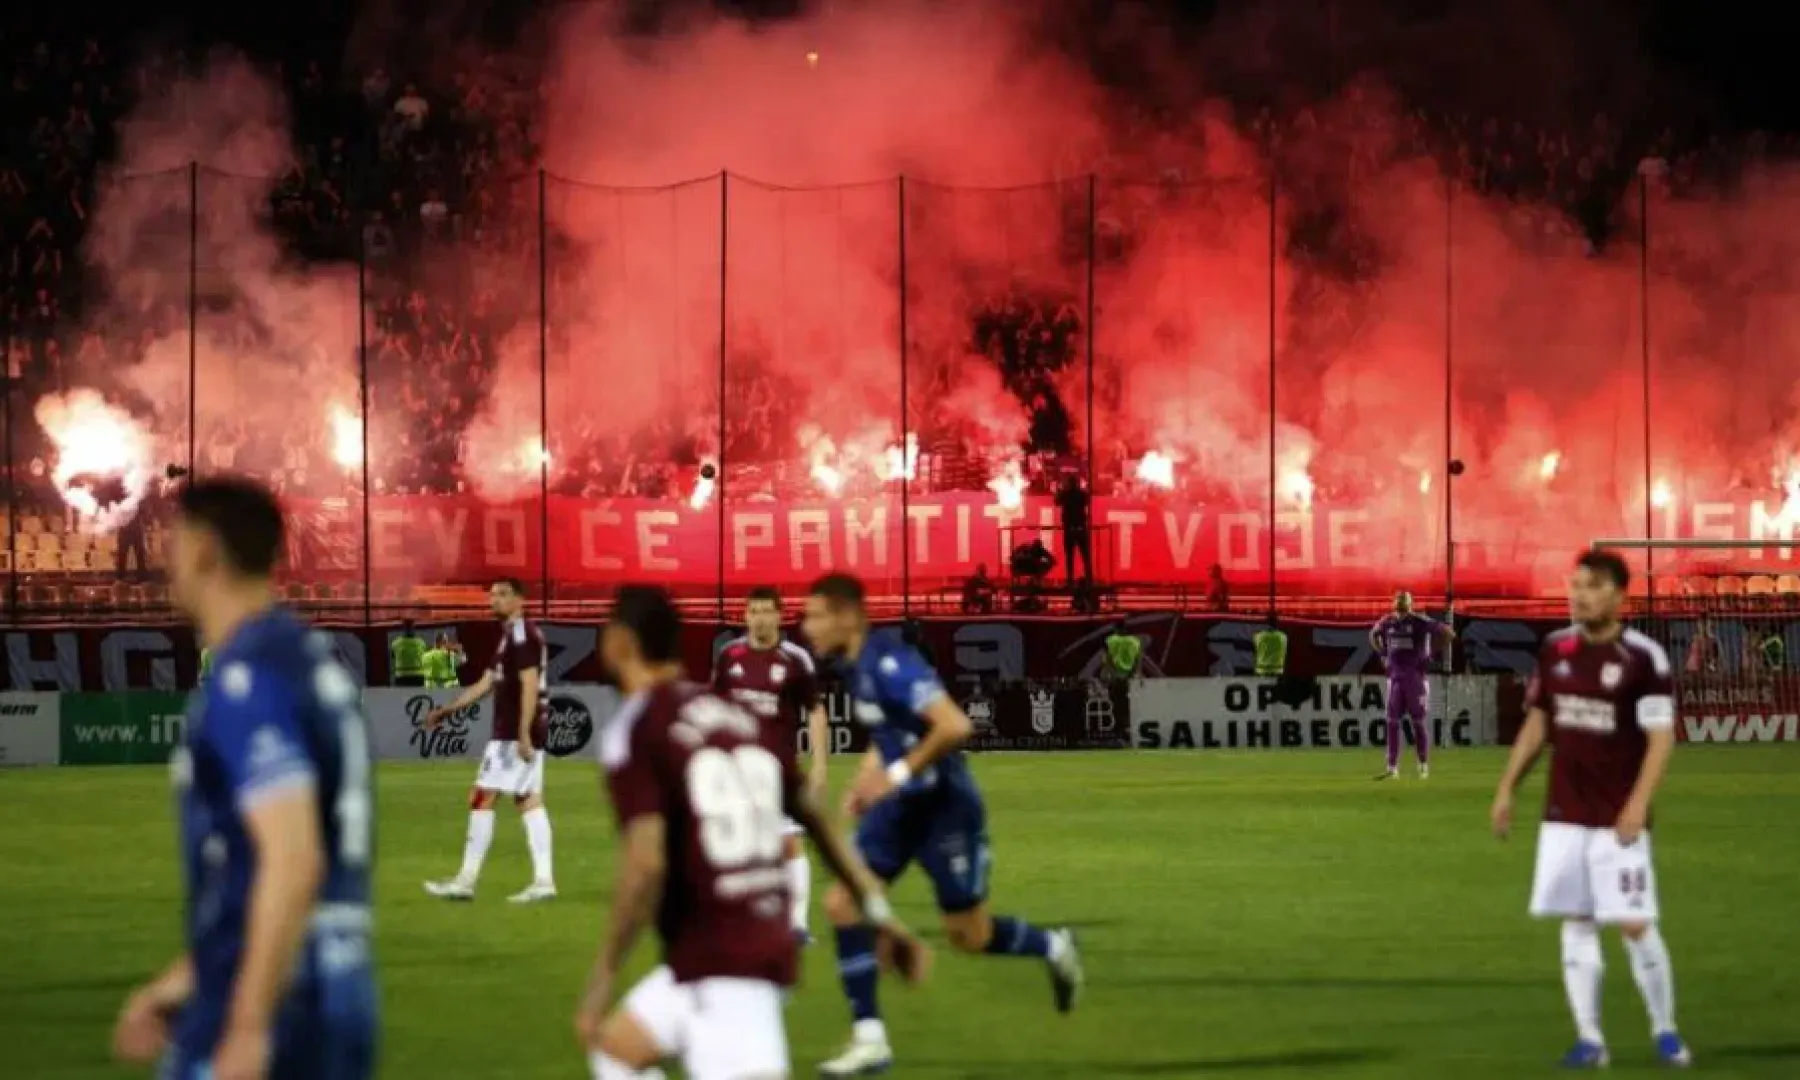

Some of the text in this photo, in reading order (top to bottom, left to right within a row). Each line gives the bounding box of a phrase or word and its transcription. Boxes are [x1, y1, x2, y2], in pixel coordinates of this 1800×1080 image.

[580, 499, 680, 571] ĆE
[733, 504, 1054, 571] PAMTITI
[1107, 510, 1368, 572] TVOJE
[1225, 683, 1386, 712] OPIKA
